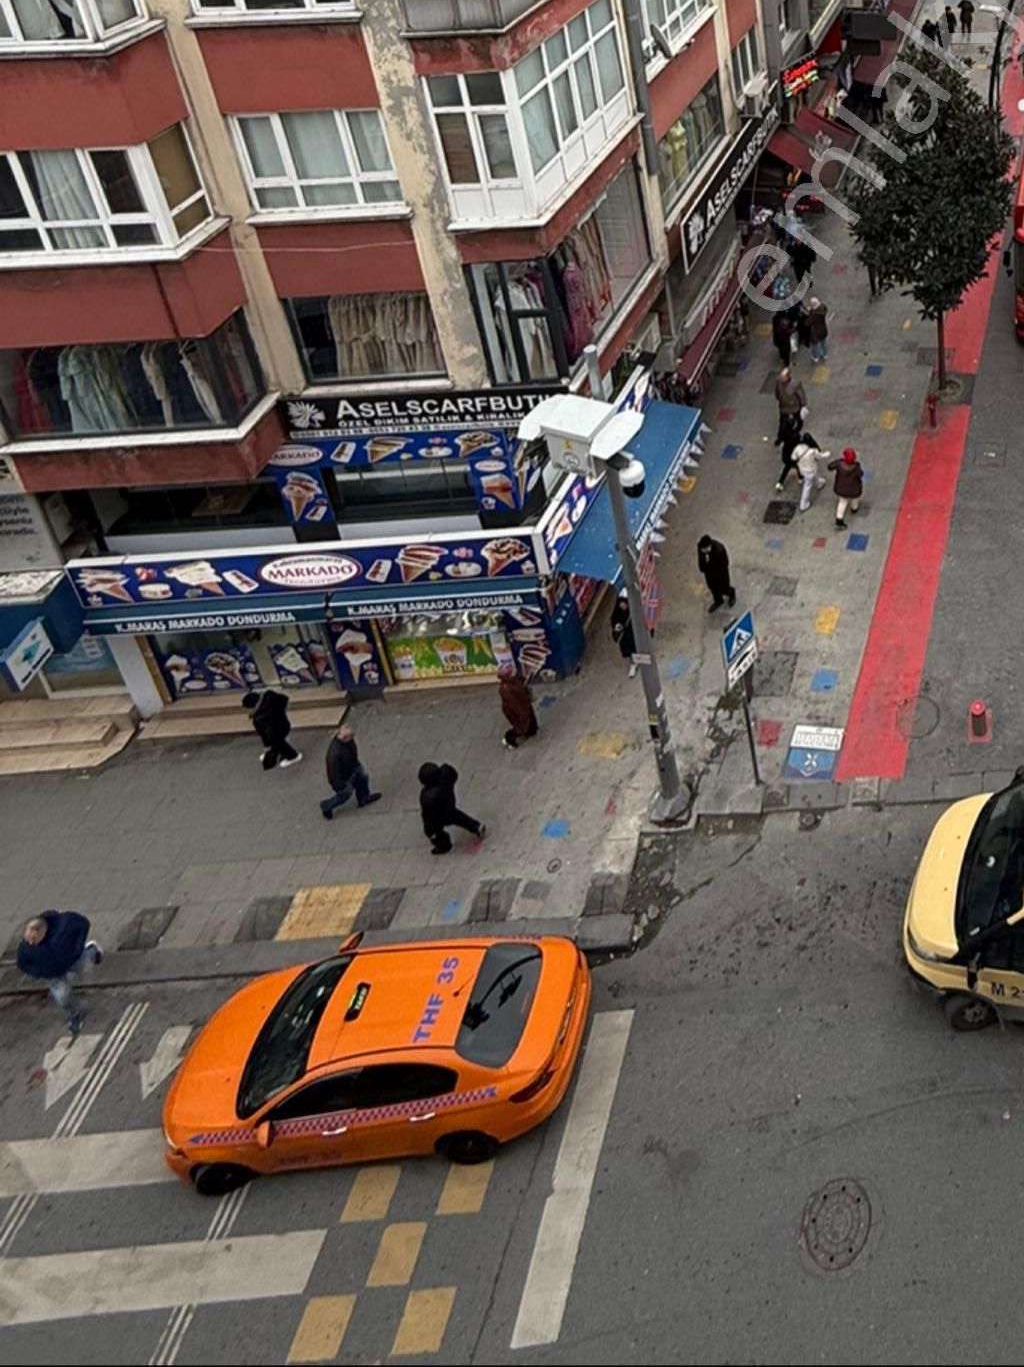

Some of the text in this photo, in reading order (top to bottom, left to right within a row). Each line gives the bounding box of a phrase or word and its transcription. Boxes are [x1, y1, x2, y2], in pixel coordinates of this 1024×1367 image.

[272, 450, 320, 461] ARKADO
[268, 565, 353, 580] MARKADO
[400, 600, 453, 612] MARKADO
[456, 593, 524, 607] DONDURMA
[169, 616, 225, 629] MARKADO
[227, 611, 296, 626] DONDURMA
[437, 956, 459, 984] 35
[991, 981, 1005, 997] M
